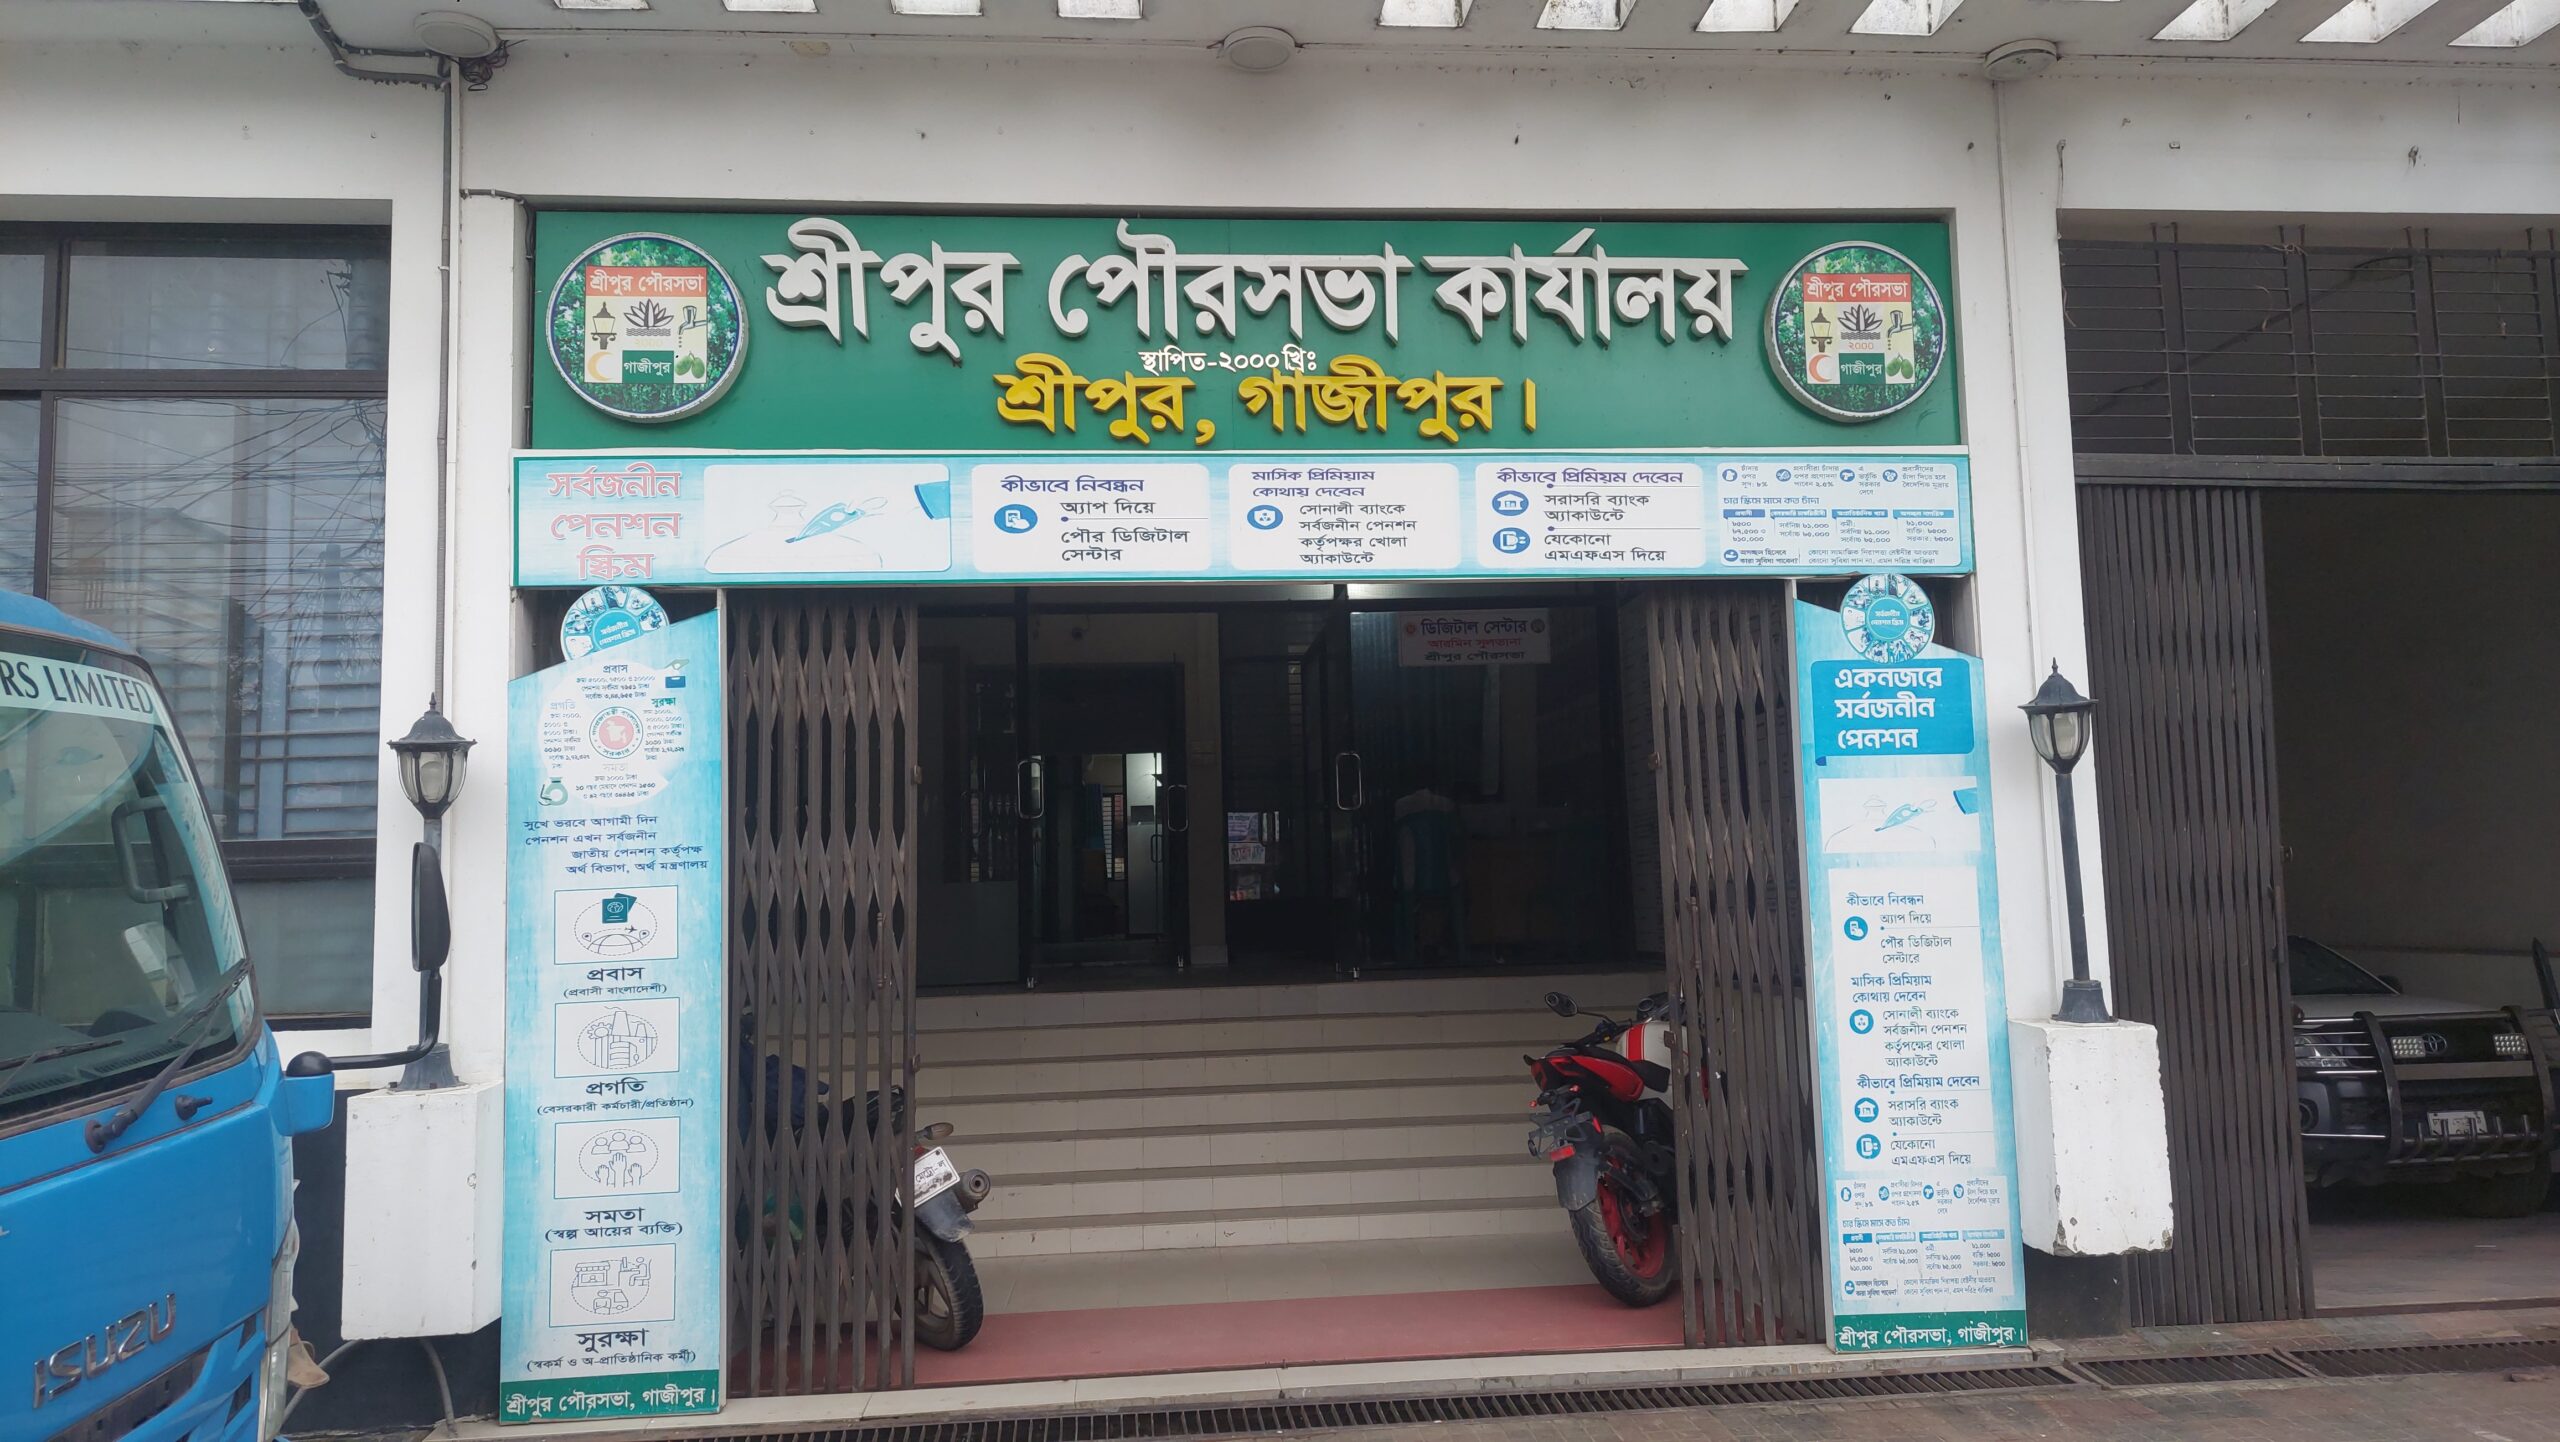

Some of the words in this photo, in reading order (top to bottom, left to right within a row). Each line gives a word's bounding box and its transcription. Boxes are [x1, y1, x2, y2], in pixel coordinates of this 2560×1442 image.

[590, 269, 634, 295] শ্রীপুর
[639, 271, 703, 292] পৌরসভা
[760, 217, 1022, 361] শ্রীপুর
[1048, 218, 1415, 345] পৌরসভা
[1421, 227, 1749, 346] কার্যালয়
[1807, 276, 1844, 300] শ্রীপুর
[1850, 277, 1908, 298] পৌরসভা
[624, 358, 672, 376] গাজীপুর
[1138, 344, 1280, 375] স্থাপিত-২০০০
[1840, 360, 1882, 377] গাজীপুর
[992, 352, 1216, 446] শ্রীপুর,
[1238, 354, 1504, 444] গাজীপুর
[547, 461, 681, 498] সর্বজনীন
[1251, 468, 1302, 481] মাসিক
[1307, 468, 1376, 482] প্রিমিয়াম
[1496, 467, 1557, 484] কীভাবে
[1632, 471, 1684, 483] দেবেন
[1001, 475, 1070, 493] কীভাবে
[1075, 475, 1144, 492] নিবন্ধন
[1252, 486, 1309, 498] কোথায়
[1315, 486, 1366, 497] দেবেন
[1060, 500, 1108, 514] অ্যাপ
[1114, 498, 1157, 514] দিয়ে
[1543, 492, 1601, 506] সরাসরি
[1608, 494, 1651, 507] ব্যাংক
[1299, 501, 1354, 515] সোনালী
[1358, 503, 1406, 515] ব্যাংকে
[1543, 508, 1625, 522] অ্যাকাউন্টে
[550, 512, 682, 540] পেনশন
[1298, 518, 1361, 532] সর্বজনীন
[1366, 519, 1417, 532] পেনশন
[1061, 527, 1105, 544] পৌর
[1111, 527, 1190, 543] ডিজিটাল
[1369, 535, 1408, 548] খোলা
[1544, 533, 1611, 546] যেকোনো
[577, 544, 654, 580] স্কিম
[1061, 546, 1124, 562] সেন্টার
[1300, 551, 1376, 565] অ্যাকাউন্টে
[1544, 549, 1625, 562] এমএফএস
[1631, 547, 1667, 561] দিয়ে
[1420, 617, 1479, 635] ডিজিটাল
[1484, 617, 1528, 634] সেন্টার
[1425, 651, 1461, 662] শ্রীপুর
[1467, 650, 1525, 661] পৌরসভা
[1834, 667, 1943, 689] একনজরে
[43, 665, 154, 714] LIMITED
[1834, 691, 1936, 719] সর্বজনীন
[1837, 729, 1919, 749] পেনশন
[523, 819, 549, 831] সুখে
[554, 818, 585, 828] ভরবে
[591, 814, 633, 827] আগামী
[637, 813, 658, 825] দিন
[525, 834, 569, 846] পেনশন
[573, 833, 601, 843] এখন
[607, 829, 658, 842] সর্বজনীন
[572, 847, 609, 860] জাতীয়
[614, 847, 655, 858] পেনশন
[660, 843, 703, 859] কর্তৃপক্ষ
[566, 862, 587, 874] অর্থ
[634, 860, 655, 871] অর্থ
[660, 859, 709, 871] মন্ত্রণালয়
[1846, 892, 1884, 907] কীভাবে
[1888, 892, 1924, 906] নিবন্ধন
[1880, 912, 1905, 925] অ্যাপ
[1909, 911, 1932, 924] দিয়ে
[1880, 936, 1903, 949] পৌর
[1908, 935, 1952, 948] ডিজিটাল
[1882, 951, 1920, 964] সেন্টারে
[586, 966, 645, 982] প্রবাস
[1850, 973, 1885, 986] মাসিক
[1889, 973, 1932, 987] প্রিমিয়াম
[563, 985, 602, 999] (প্রবাসী
[607, 983, 667, 997] বাংলাদেশী)
[1852, 991, 1890, 1003] কোথায়
[1893, 990, 1926, 1002] দেবেন
[1883, 1005, 1923, 1020] সোনালী
[1926, 1007, 1959, 1020] ব্যাংকে
[1883, 1021, 1928, 1036] সর্বজনীন
[1931, 1023, 1968, 1035] পেনশন
[1937, 1038, 1965, 1051] খোলা
[1885, 1053, 1938, 1068] অ্যাকাউন্টে
[586, 1077, 647, 1096] প্রগতি
[1856, 1075, 1896, 1089] কীভাবে
[1899, 1073, 1943, 1088] প্রিমিয়াম
[1947, 1075, 1980, 1087] দেবেন
[537, 1102, 597, 1116] (বেসরকারী
[1888, 1097, 1926, 1111] সরাসরি
[1930, 1098, 1959, 1111] ব্যাংক
[1888, 1114, 1942, 1127] অ্যাকাউন্টে
[1891, 1139, 1936, 1151] যেকোনো
[1892, 1154, 1945, 1166] এমএফএস
[1949, 1152, 1971, 1165] দিয়ে
[584, 1207, 645, 1224] সমতা
[545, 1228, 577, 1243] (স্বল্প
[585, 1226, 632, 1238] আয়ের
[639, 1221, 683, 1236] ব্যক্তি)
[575, 1327, 650, 1353] সুরক্ষা
[1839, 1326, 1879, 1349] শ্রীপুর
[1884, 1325, 1951, 1345] পৌরসভা,
[1957, 1322, 2015, 1346] গাজীপুর
[32, 1292, 176, 1409] ISUZU
[506, 1392, 554, 1417] শ্রীপুর
[559, 1389, 636, 1411] পৌরসভা,
[643, 1384, 706, 1408] গাজীপুর
